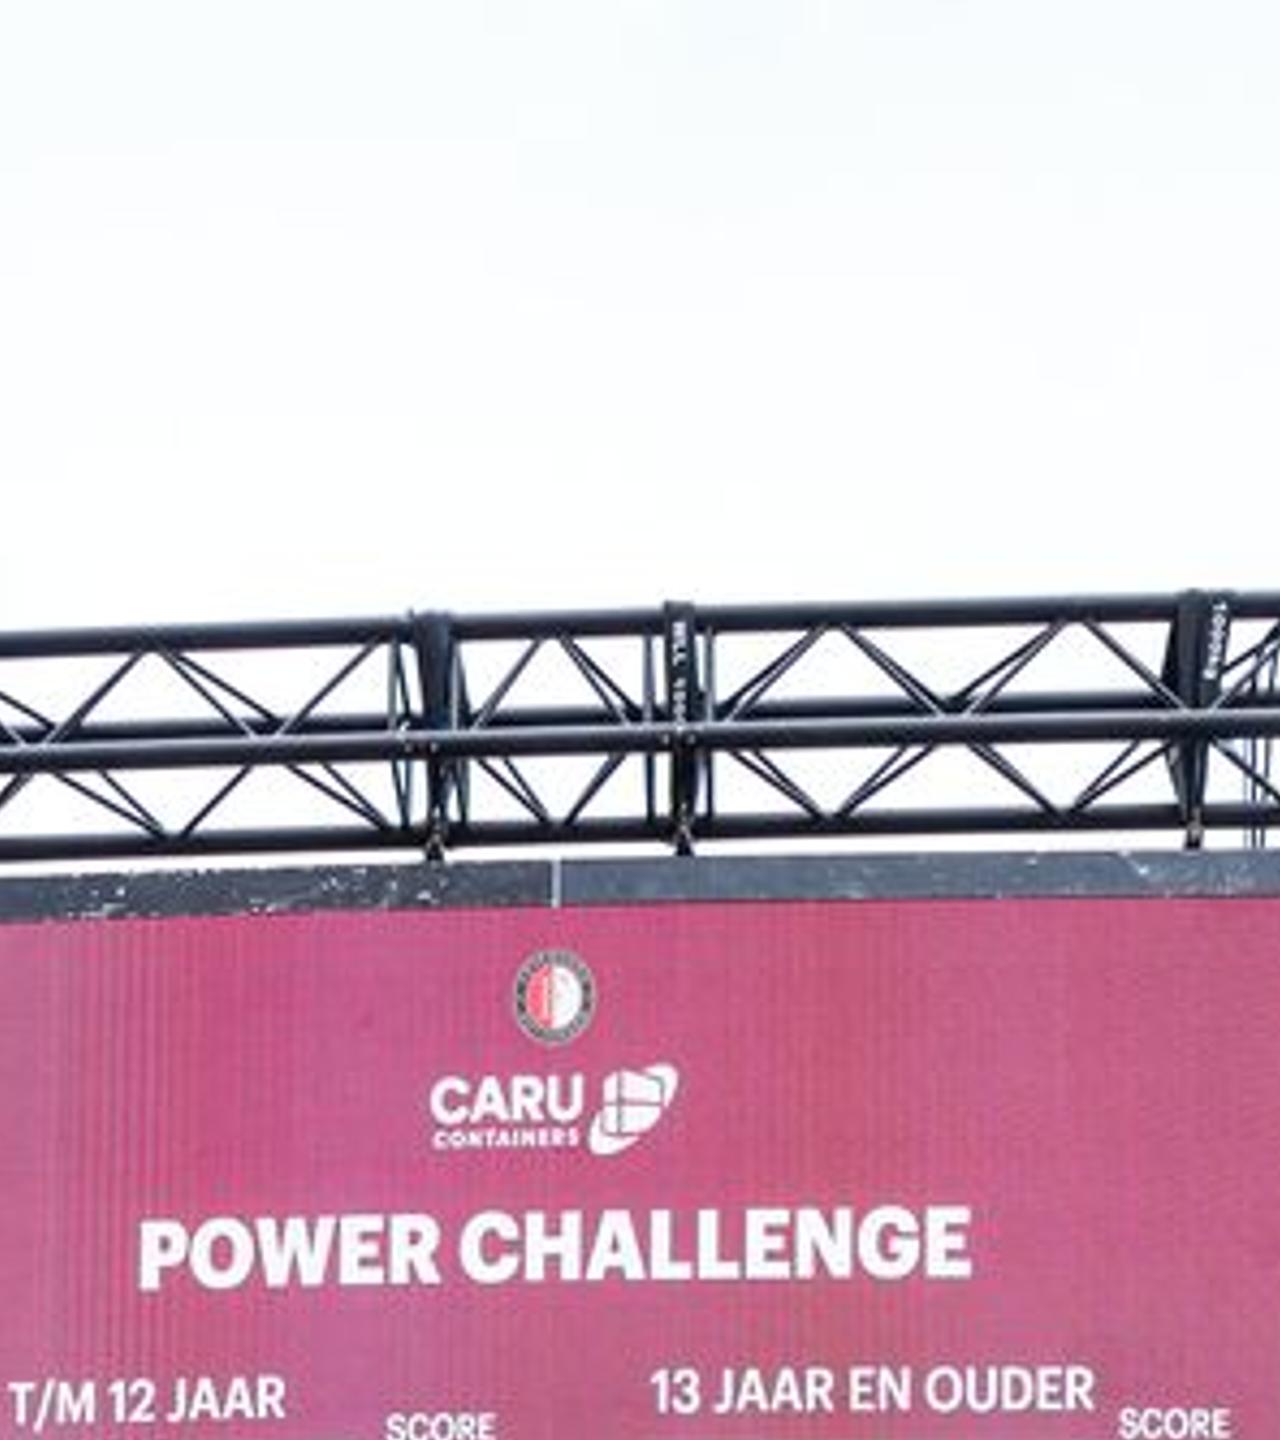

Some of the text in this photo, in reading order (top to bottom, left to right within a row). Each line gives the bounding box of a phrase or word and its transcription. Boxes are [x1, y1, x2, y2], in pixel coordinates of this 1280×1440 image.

[430, 1073, 584, 1124] CARU
[433, 1128, 579, 1148] CONTAINERS
[139, 1205, 972, 1291] POWER CHALLENGE
[8, 1375, 285, 1432] T/M 12 JAAR
[650, 1365, 1094, 1414] 13 JAAR EN OUDER
[1119, 1407, 1230, 1440] SCORE
